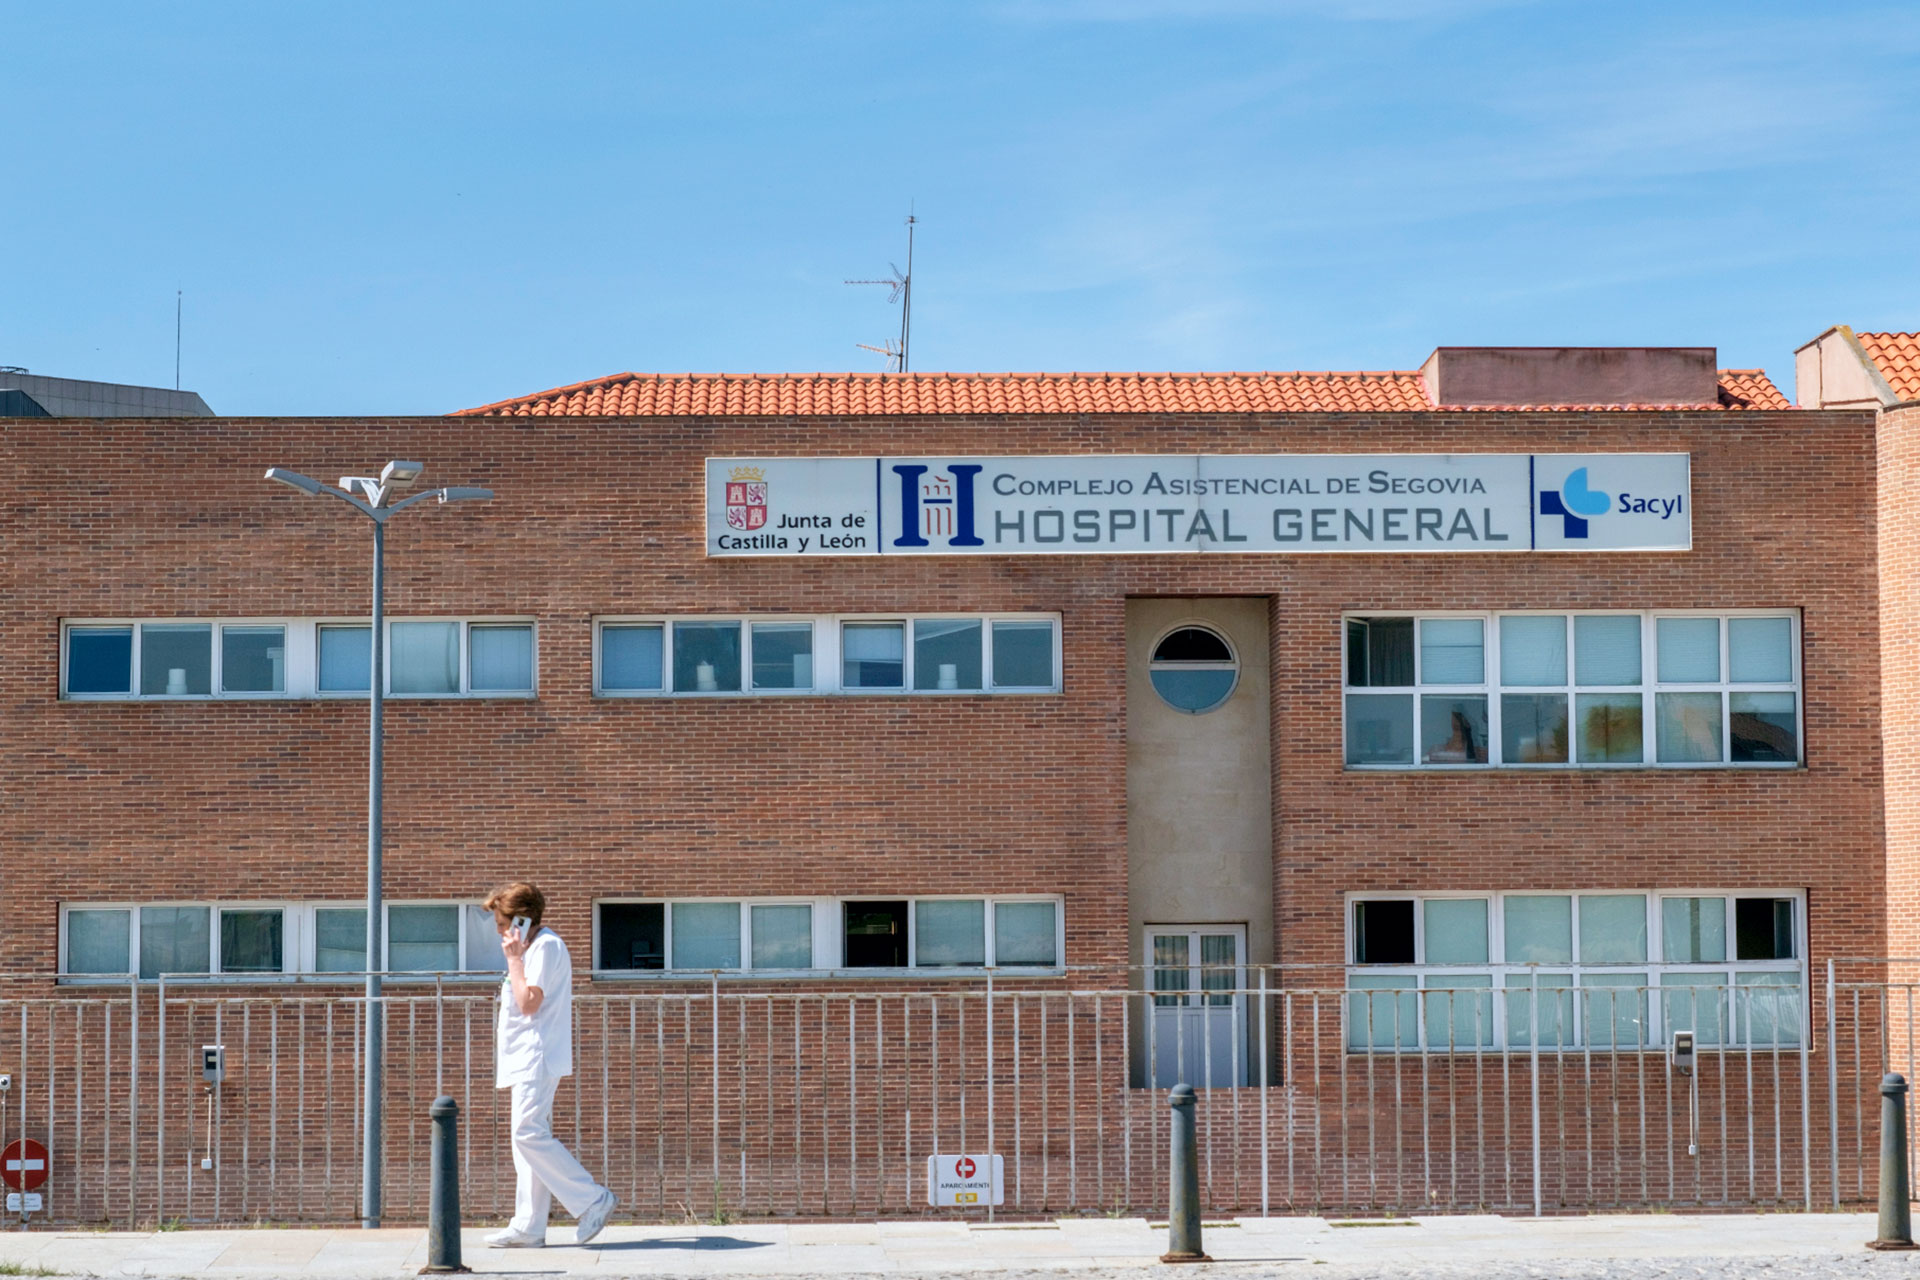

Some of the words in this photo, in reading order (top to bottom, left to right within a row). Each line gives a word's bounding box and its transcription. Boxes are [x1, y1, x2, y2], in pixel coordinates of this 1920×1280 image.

[993, 473, 1133, 496] COMPLEJO
[1142, 472, 1320, 495] ASISTENCIAL
[1327, 478, 1360, 494] DE
[1368, 470, 1487, 495] SEGOVIA
[1618, 493, 1683, 520] Sacyl
[777, 513, 832, 529] Junta
[841, 512, 866, 529] de
[994, 508, 1248, 544] HOSPITAL
[1273, 507, 1509, 542] GENERAL
[717, 534, 788, 550] Castilla
[797, 536, 810, 553] y
[819, 533, 866, 549] León
